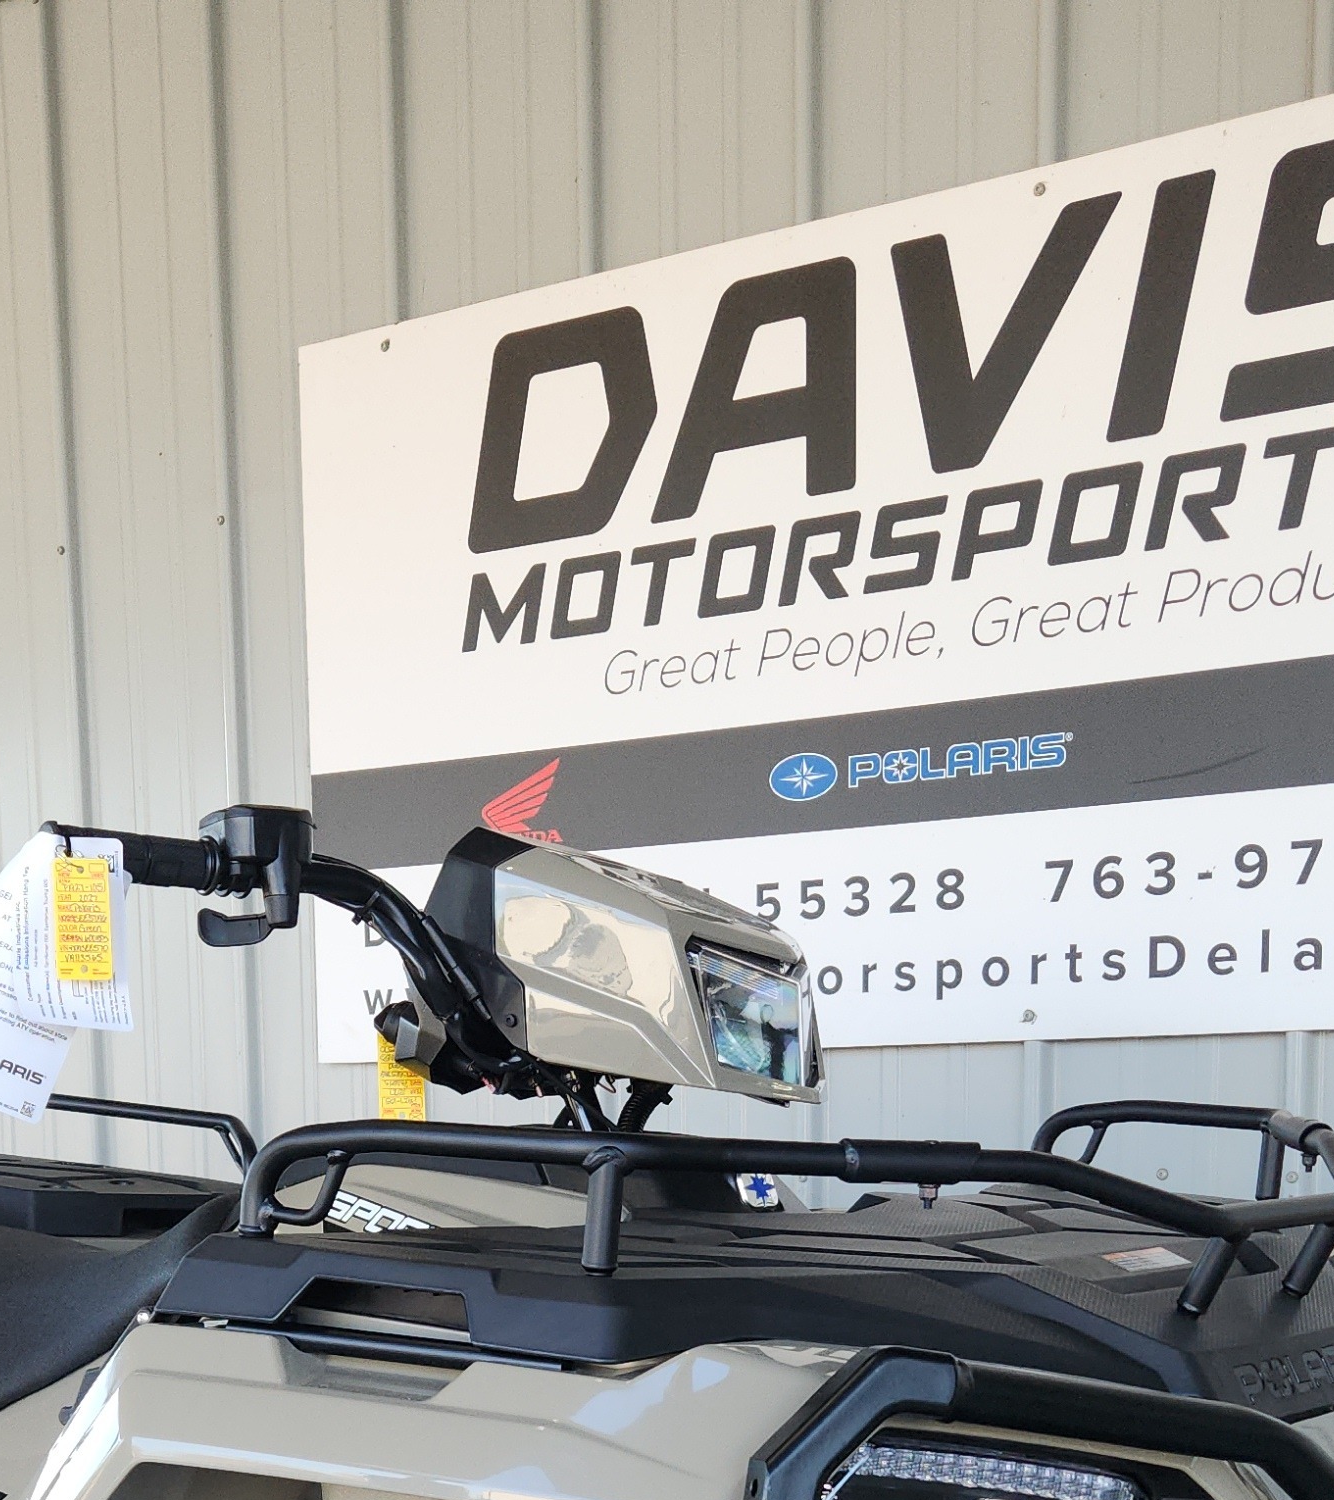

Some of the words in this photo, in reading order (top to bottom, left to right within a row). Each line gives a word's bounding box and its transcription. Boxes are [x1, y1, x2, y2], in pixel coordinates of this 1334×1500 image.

[604, 637, 741, 696] Great
[757, 609, 945, 678] People,
[971, 580, 1138, 648] Great
[848, 732, 1067, 788] POLARIS
[755, 868, 965, 921] 55328
[0, 961, 14, 974] ONL
